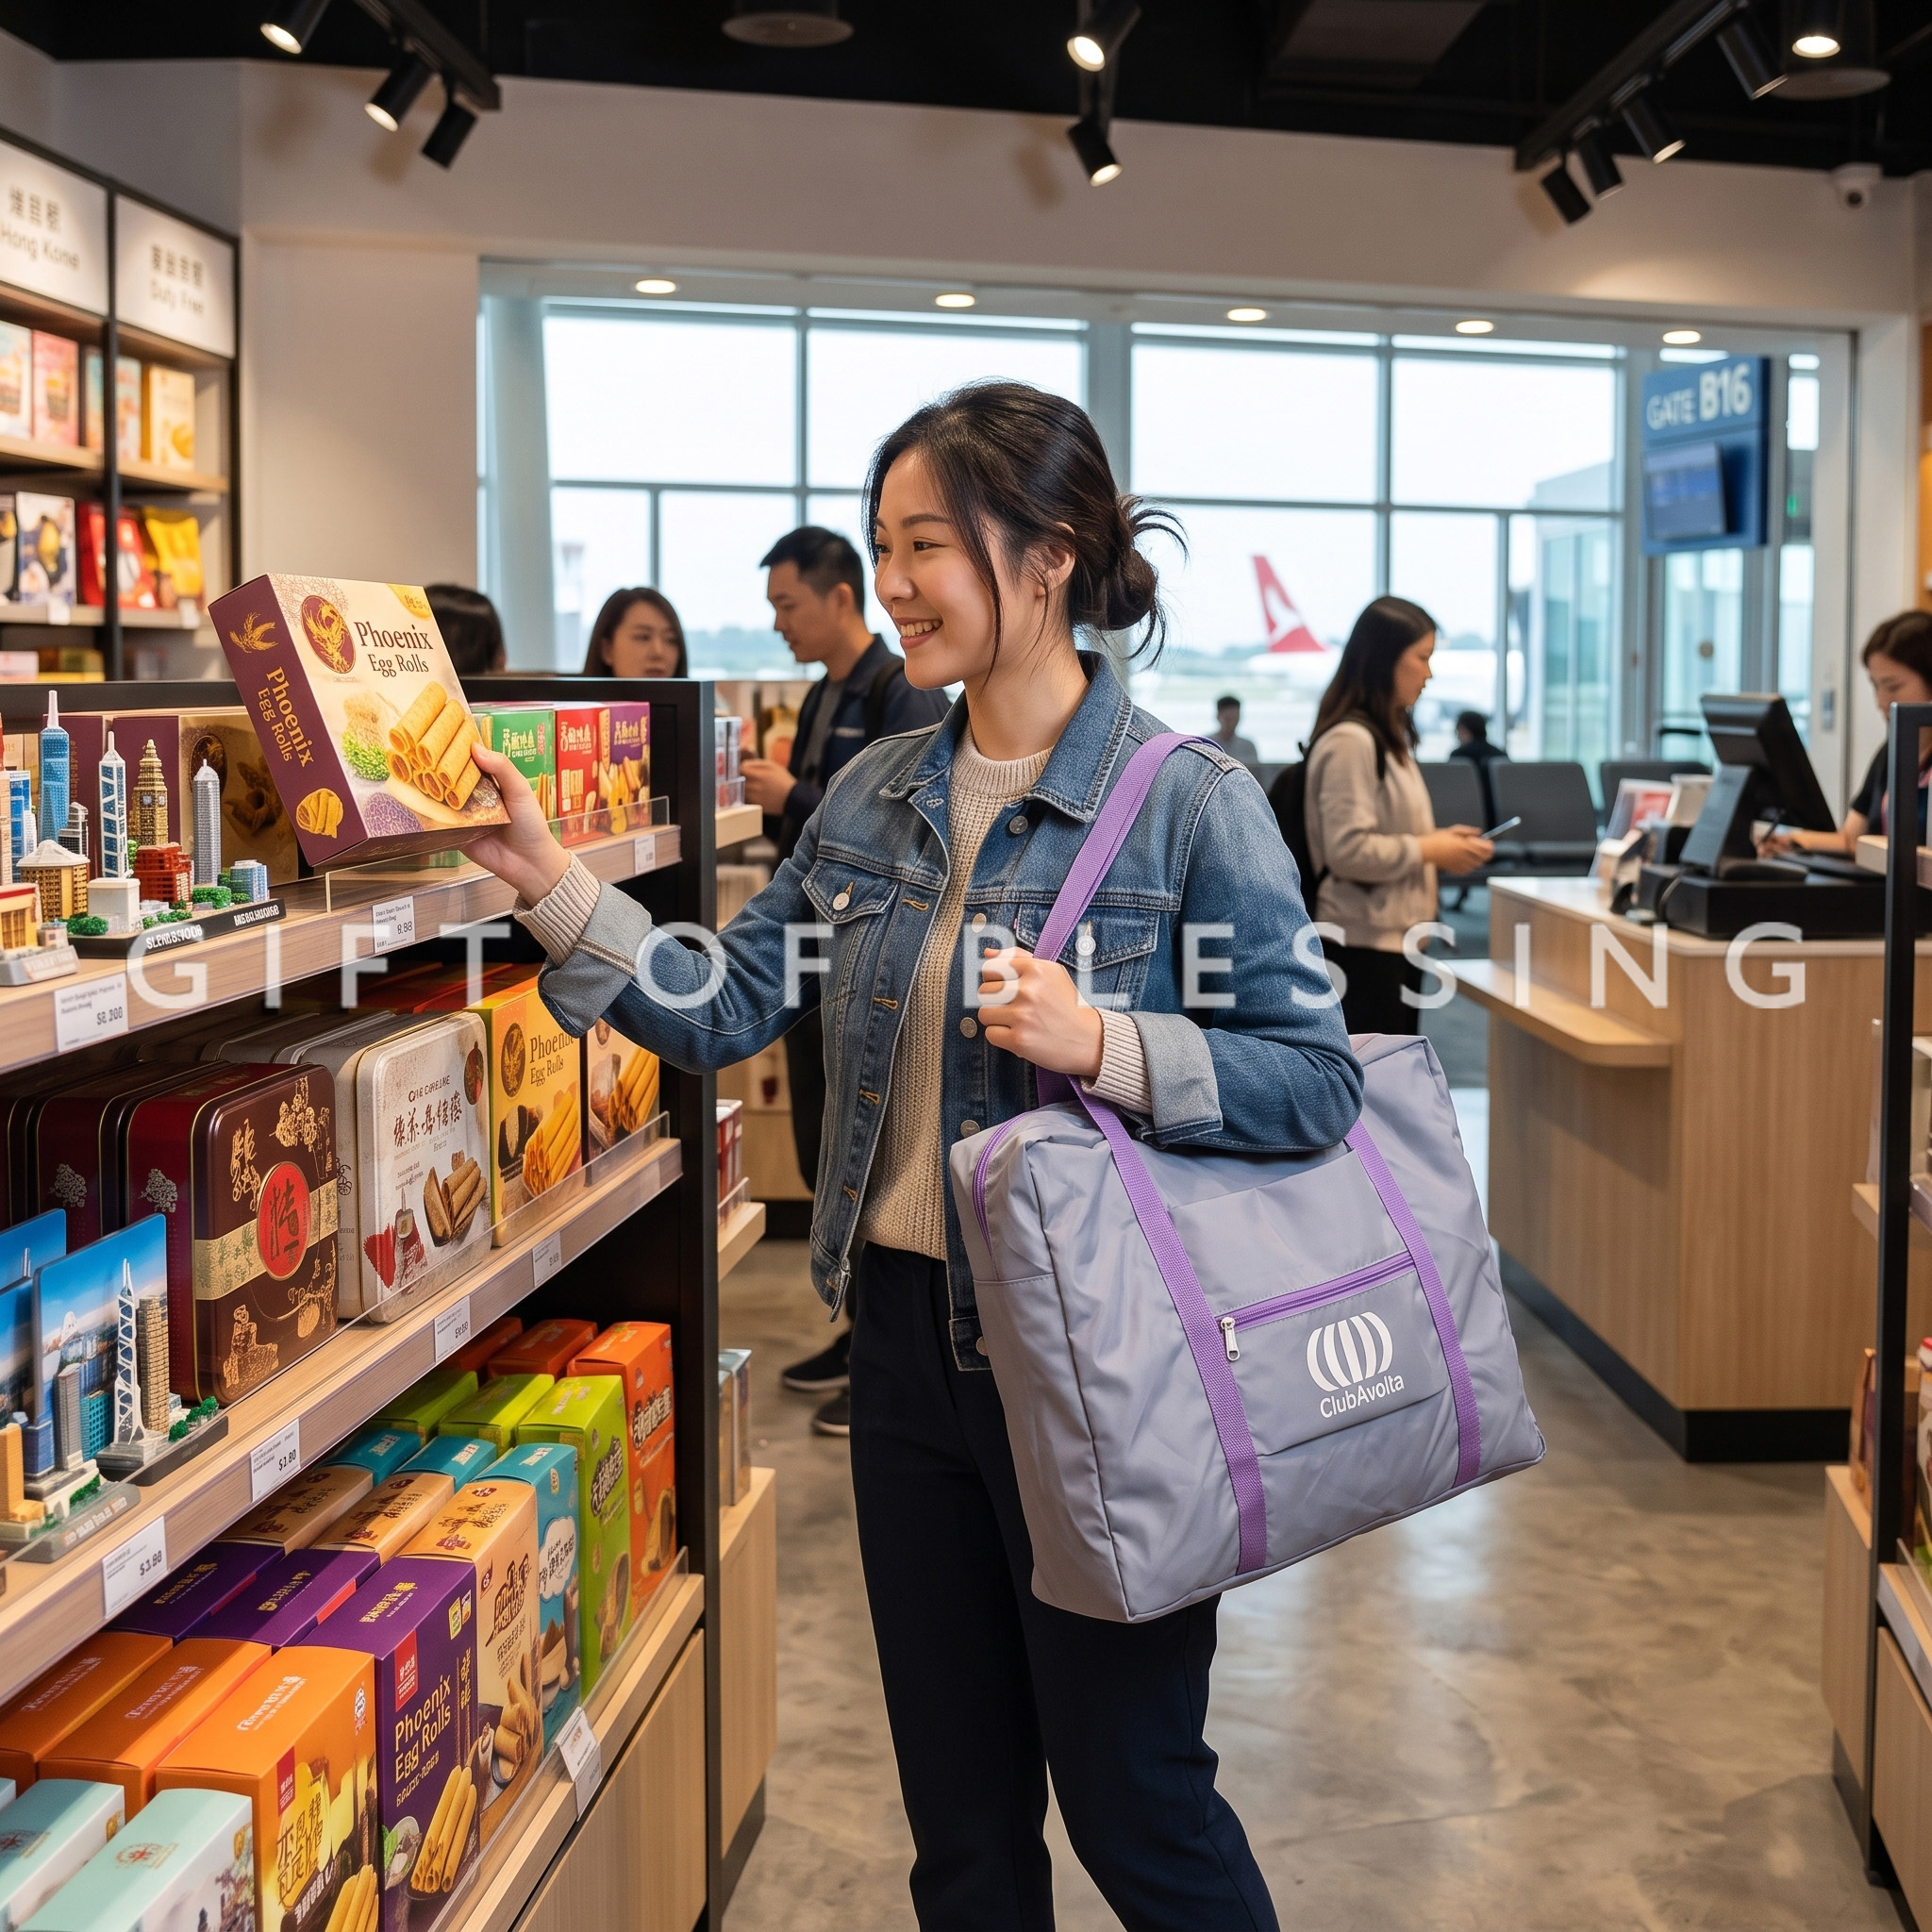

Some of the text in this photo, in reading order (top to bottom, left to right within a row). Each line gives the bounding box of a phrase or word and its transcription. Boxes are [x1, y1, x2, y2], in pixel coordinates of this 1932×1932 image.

[1646, 361, 1753, 431] GATE B16
[354, 621, 433, 650] Phoenix
[367, 654, 429, 677] Egg Rolls
[258, 687, 293, 762] Egg Rolls
[266, 666, 314, 768] Phoenix
[1320, 1374, 1405, 1419] ClubAvolta
[395, 1674, 451, 1753] Phoenix
[395, 1740, 419, 1785] Egg
[422, 1703, 451, 1753] Rolls
